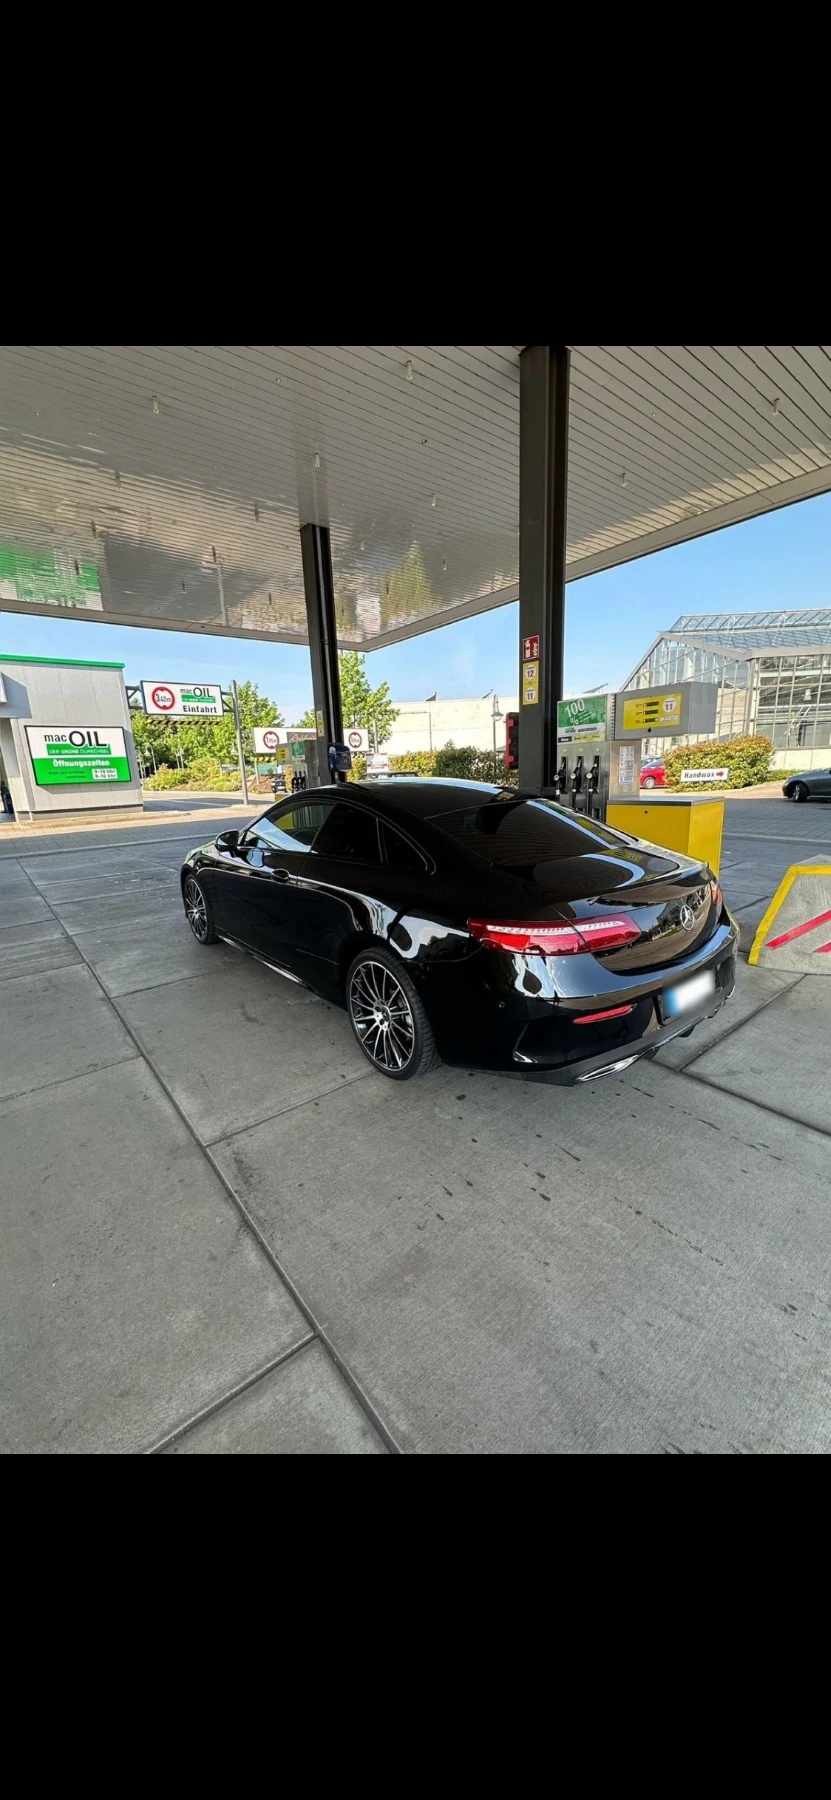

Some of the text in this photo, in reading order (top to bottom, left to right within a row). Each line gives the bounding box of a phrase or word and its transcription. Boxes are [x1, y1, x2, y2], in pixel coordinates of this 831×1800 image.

[527, 670, 534, 678] 12
[193, 687, 214, 697] OIL
[182, 705, 217, 713] Einfahrt
[565, 698, 585, 717] 100
[665, 703, 673, 711] 11
[68, 730, 108, 747] OIL
[53, 758, 110, 768] Öffnungszeiten
